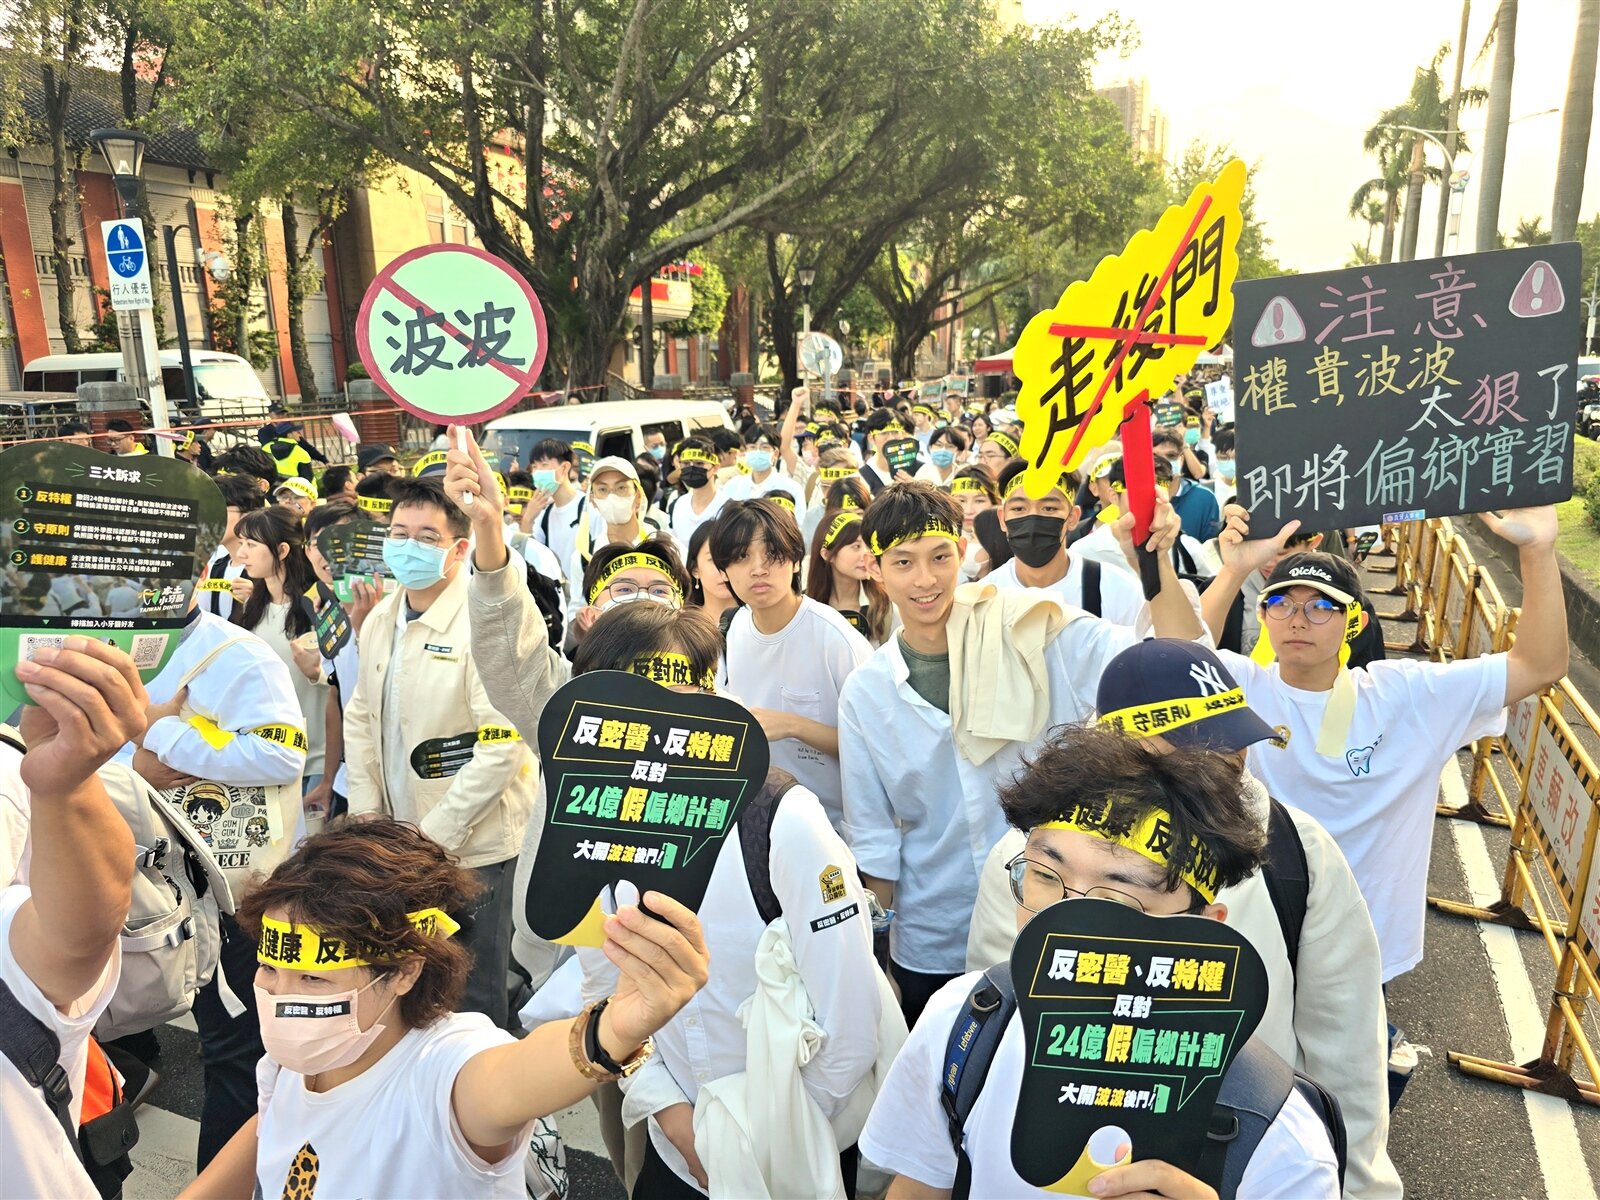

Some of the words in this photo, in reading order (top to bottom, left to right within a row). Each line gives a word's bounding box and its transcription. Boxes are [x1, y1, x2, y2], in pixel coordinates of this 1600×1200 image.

[112, 282, 149, 295] 行人優先
[1313, 260, 1488, 345] 注意
[381, 301, 526, 376] 波波
[1035, 215, 1226, 469] 走後門
[1239, 340, 1463, 416] 權貴波波
[1407, 362, 1569, 432] 太狠了
[88, 465, 142, 484] 三大訴求
[1243, 421, 1570, 519] 即將偏鄉實習
[35, 490, 73, 506] 反特權
[33, 522, 71, 537] 守原則
[30, 553, 68, 567] 護健康
[1288, 566, 1332, 582] Dickies
[159, 593, 185, 606] 小牙醫
[161, 585, 183, 596] 本土
[140, 606, 162, 614] TAIWAN
[70, 619, 135, 628] 掃描加入小牙醫好友
[1189, 660, 1230, 698] NY
[1132, 703, 1191, 733] 守原則
[572, 714, 736, 763] 反密醫、反特權
[630, 759, 668, 784] 反對
[564, 784, 731, 831] 24億假偏鄉計劃
[221, 829, 236, 837] GUM
[222, 820, 237, 828] GUM
[1047, 948, 1227, 993] 反密醫、反特權
[1112, 993, 1152, 1019] 反對
[957, 1020, 978, 1052] Lefebvre
[1046, 1022, 1226, 1069] 24億假偏鄉計劃
